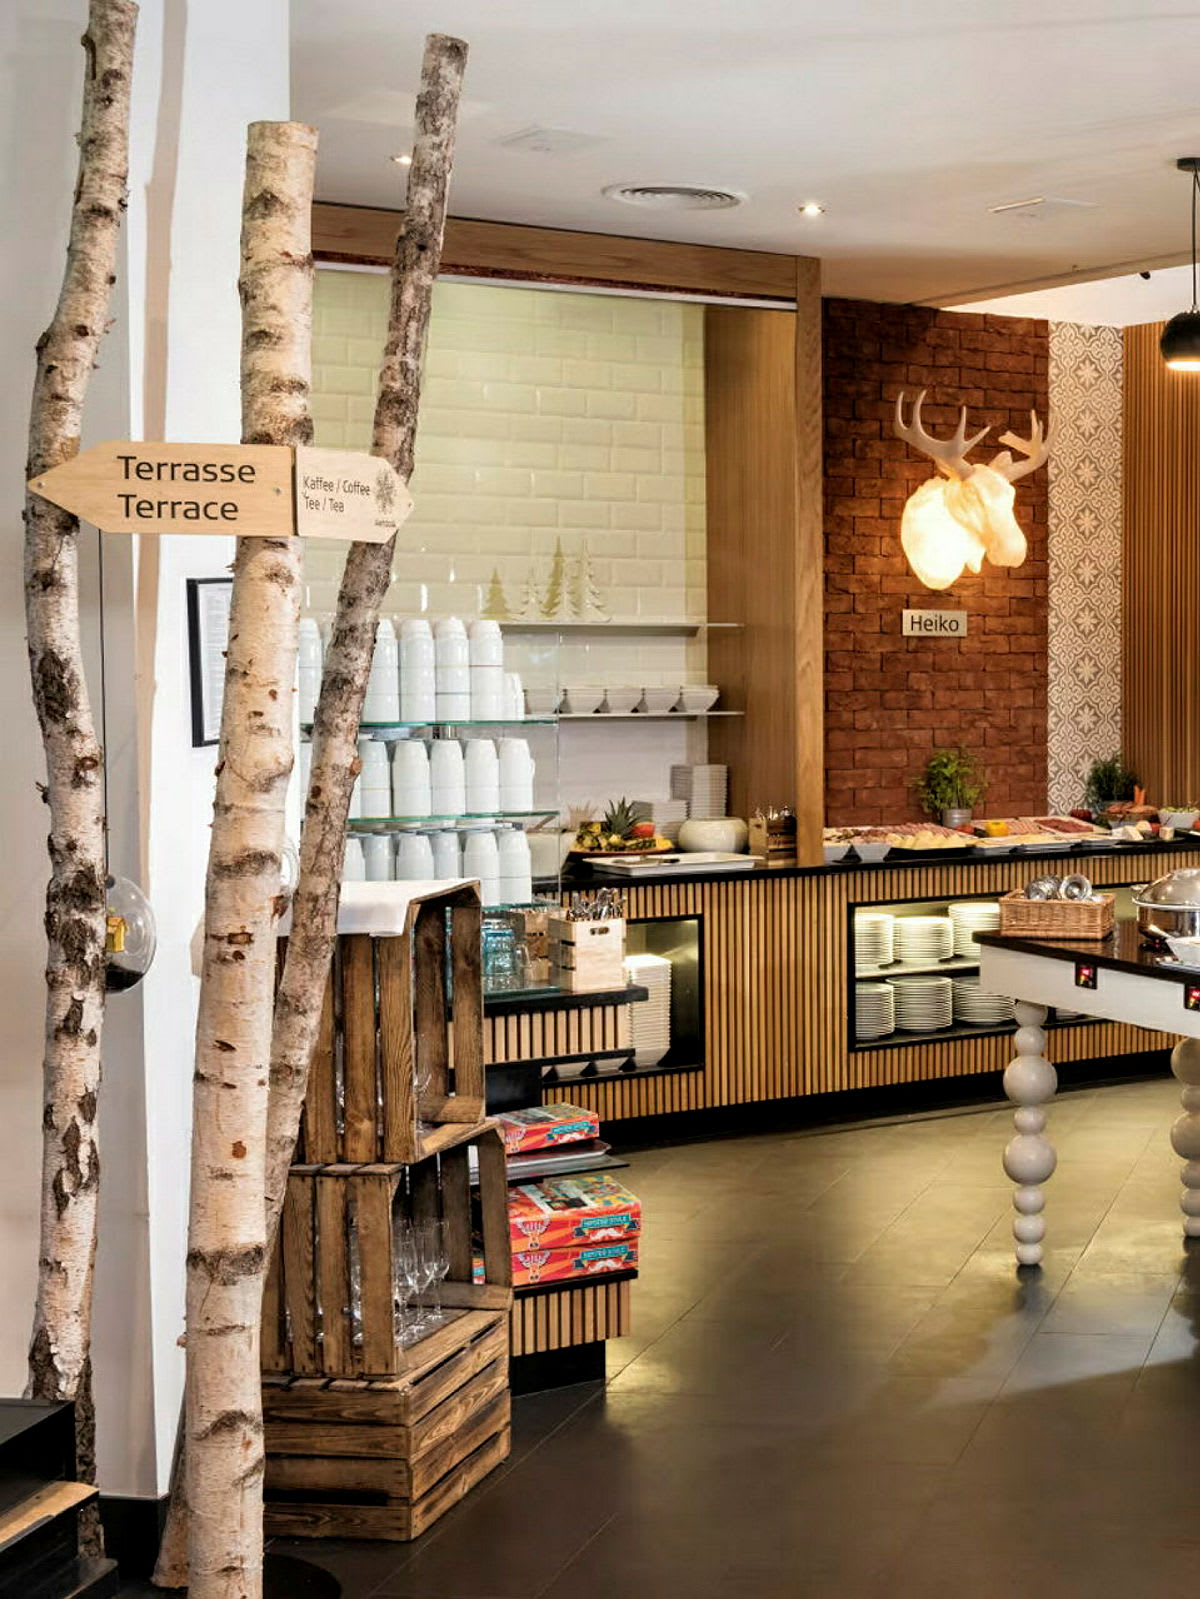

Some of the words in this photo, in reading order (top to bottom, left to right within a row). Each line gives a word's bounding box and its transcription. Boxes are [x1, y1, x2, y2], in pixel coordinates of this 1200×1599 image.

[117, 455, 256, 483] Terrasse
[303, 475, 334, 492] Kaffee
[343, 480, 371, 496] Coffee
[117, 493, 239, 521] Terrace
[329, 498, 345, 513] Tea
[911, 615, 959, 632] Heiko
